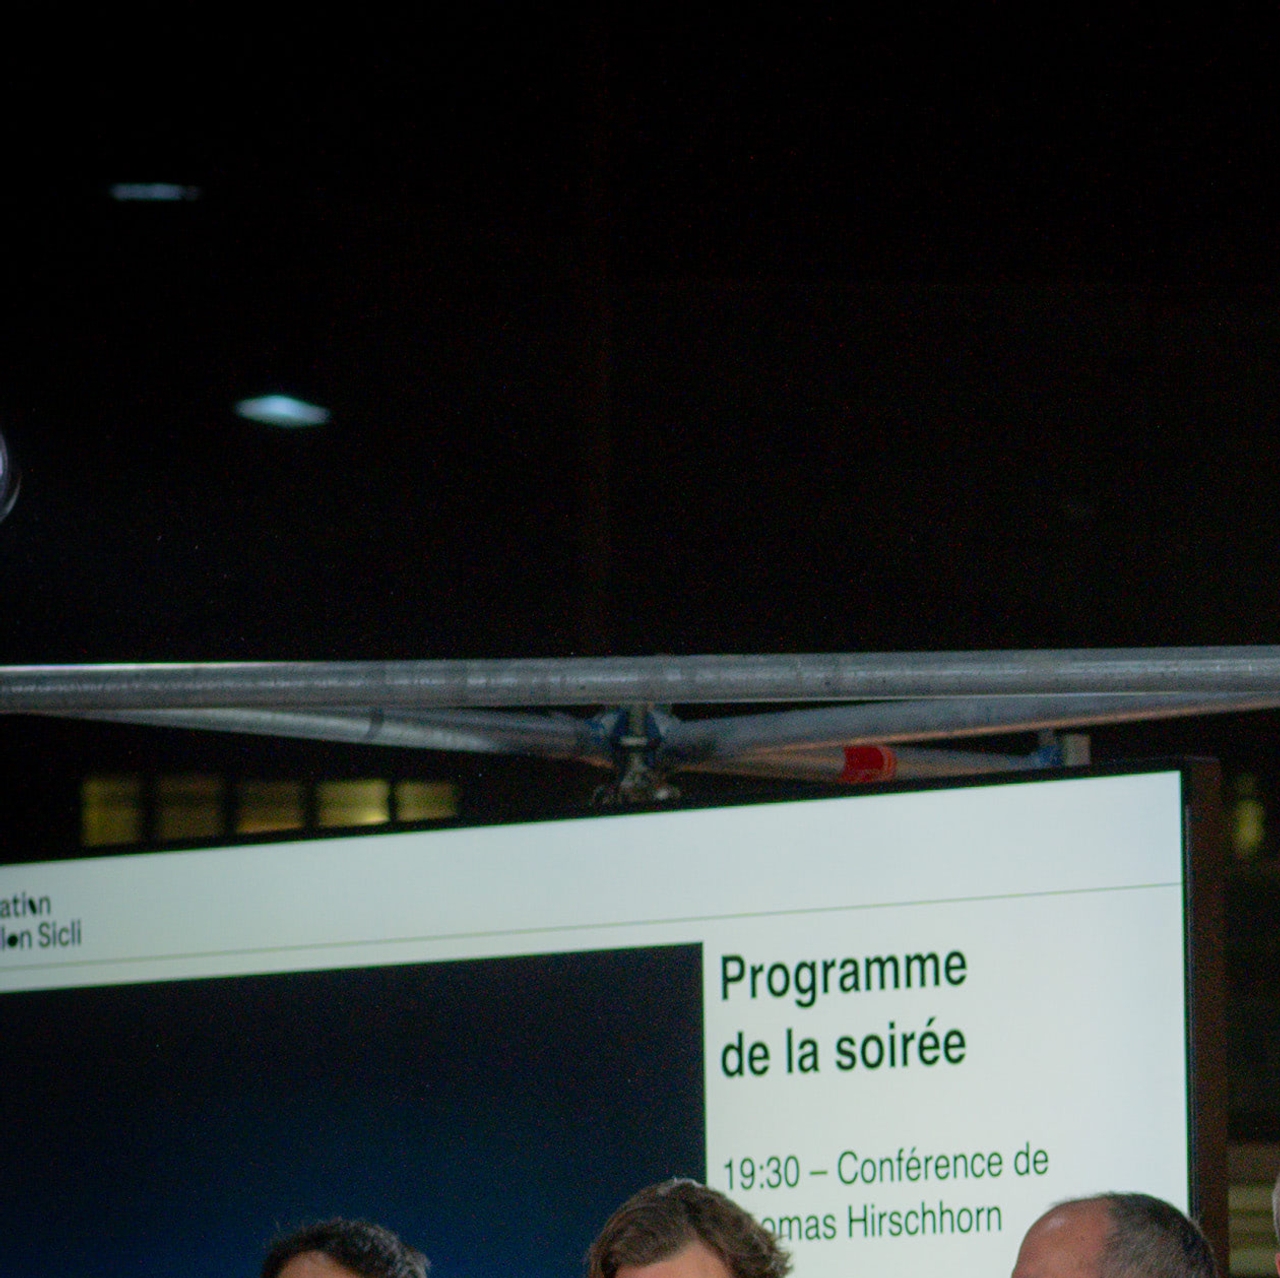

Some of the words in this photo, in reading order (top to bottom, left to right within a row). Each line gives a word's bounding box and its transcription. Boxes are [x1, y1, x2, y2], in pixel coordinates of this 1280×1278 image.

[0, 891, 52, 919] ation
[38, 919, 83, 950] Sicli
[720, 949, 968, 1011] Programme
[720, 1029, 771, 1079] de
[786, 1026, 821, 1076] la
[835, 1015, 967, 1073] soirée
[723, 1154, 801, 1191] 19:30
[836, 1146, 1004, 1187] Conférence
[1013, 1140, 1050, 1178] de
[761, 1213, 838, 1242] omas
[847, 1199, 1003, 1239] Hirschhorn
